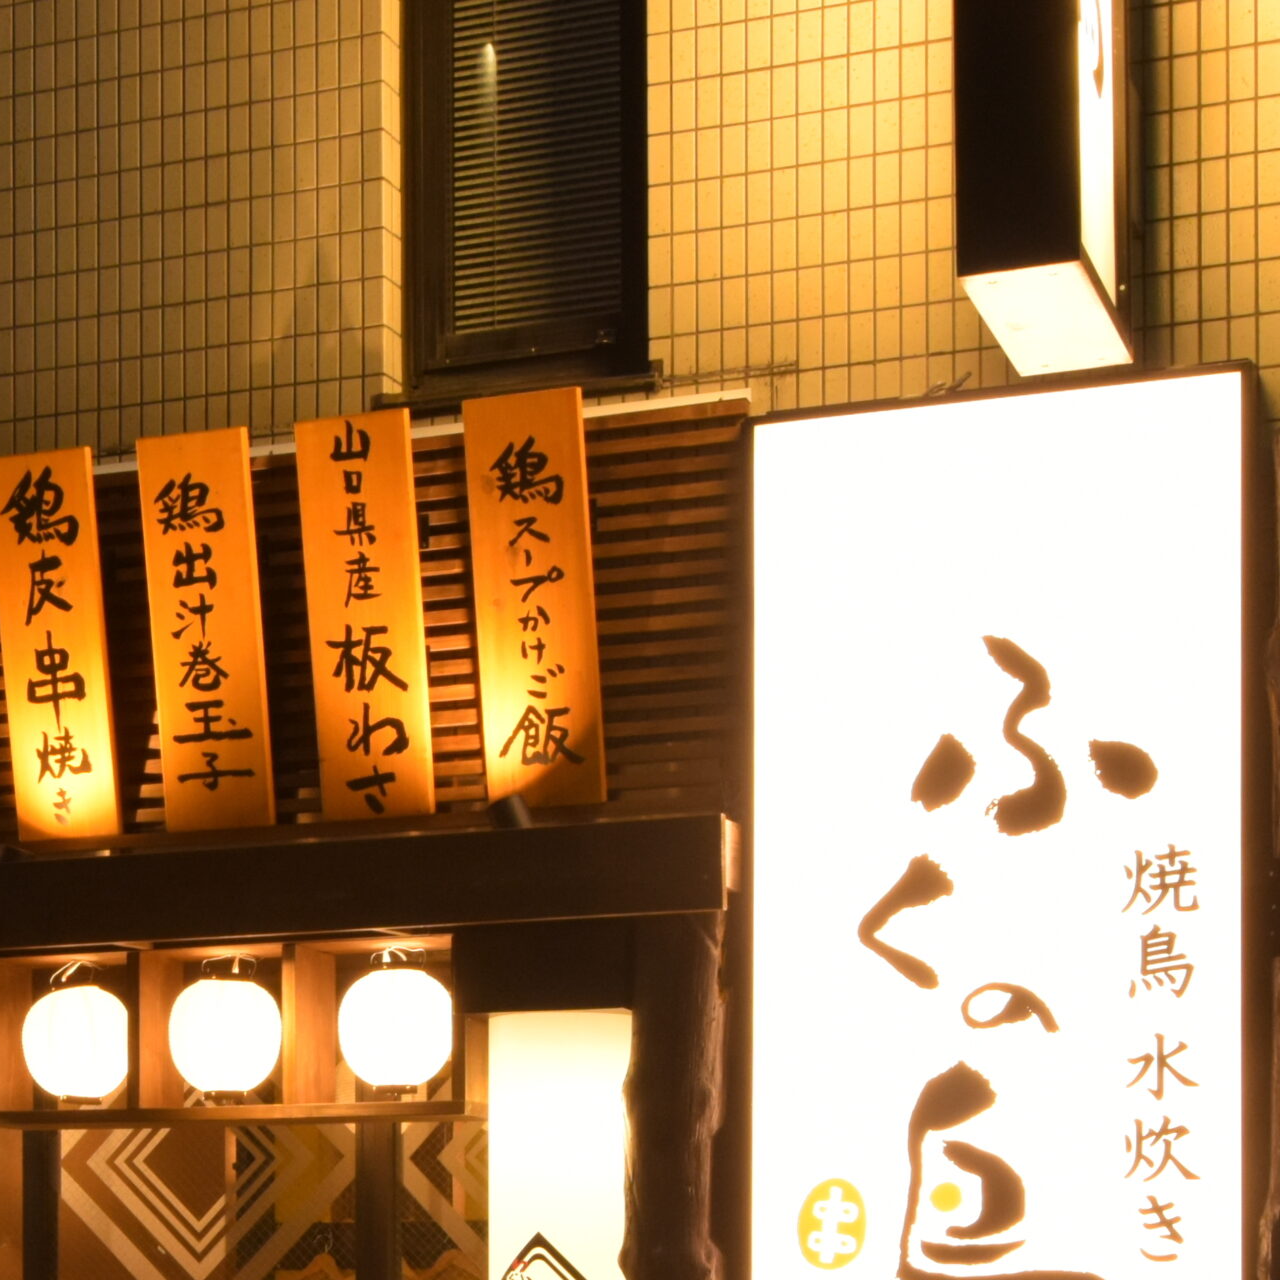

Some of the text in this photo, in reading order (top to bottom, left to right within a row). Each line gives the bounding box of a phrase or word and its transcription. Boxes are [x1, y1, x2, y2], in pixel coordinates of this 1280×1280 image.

[0, 465, 92, 824] 鶏皮串焼き
[153, 473, 255, 791] 鶏出汁巻玉子
[489, 435, 585, 766] 鶏スープかけご飯
[1121, 843, 1201, 1262] 焼鳥 水炊き
